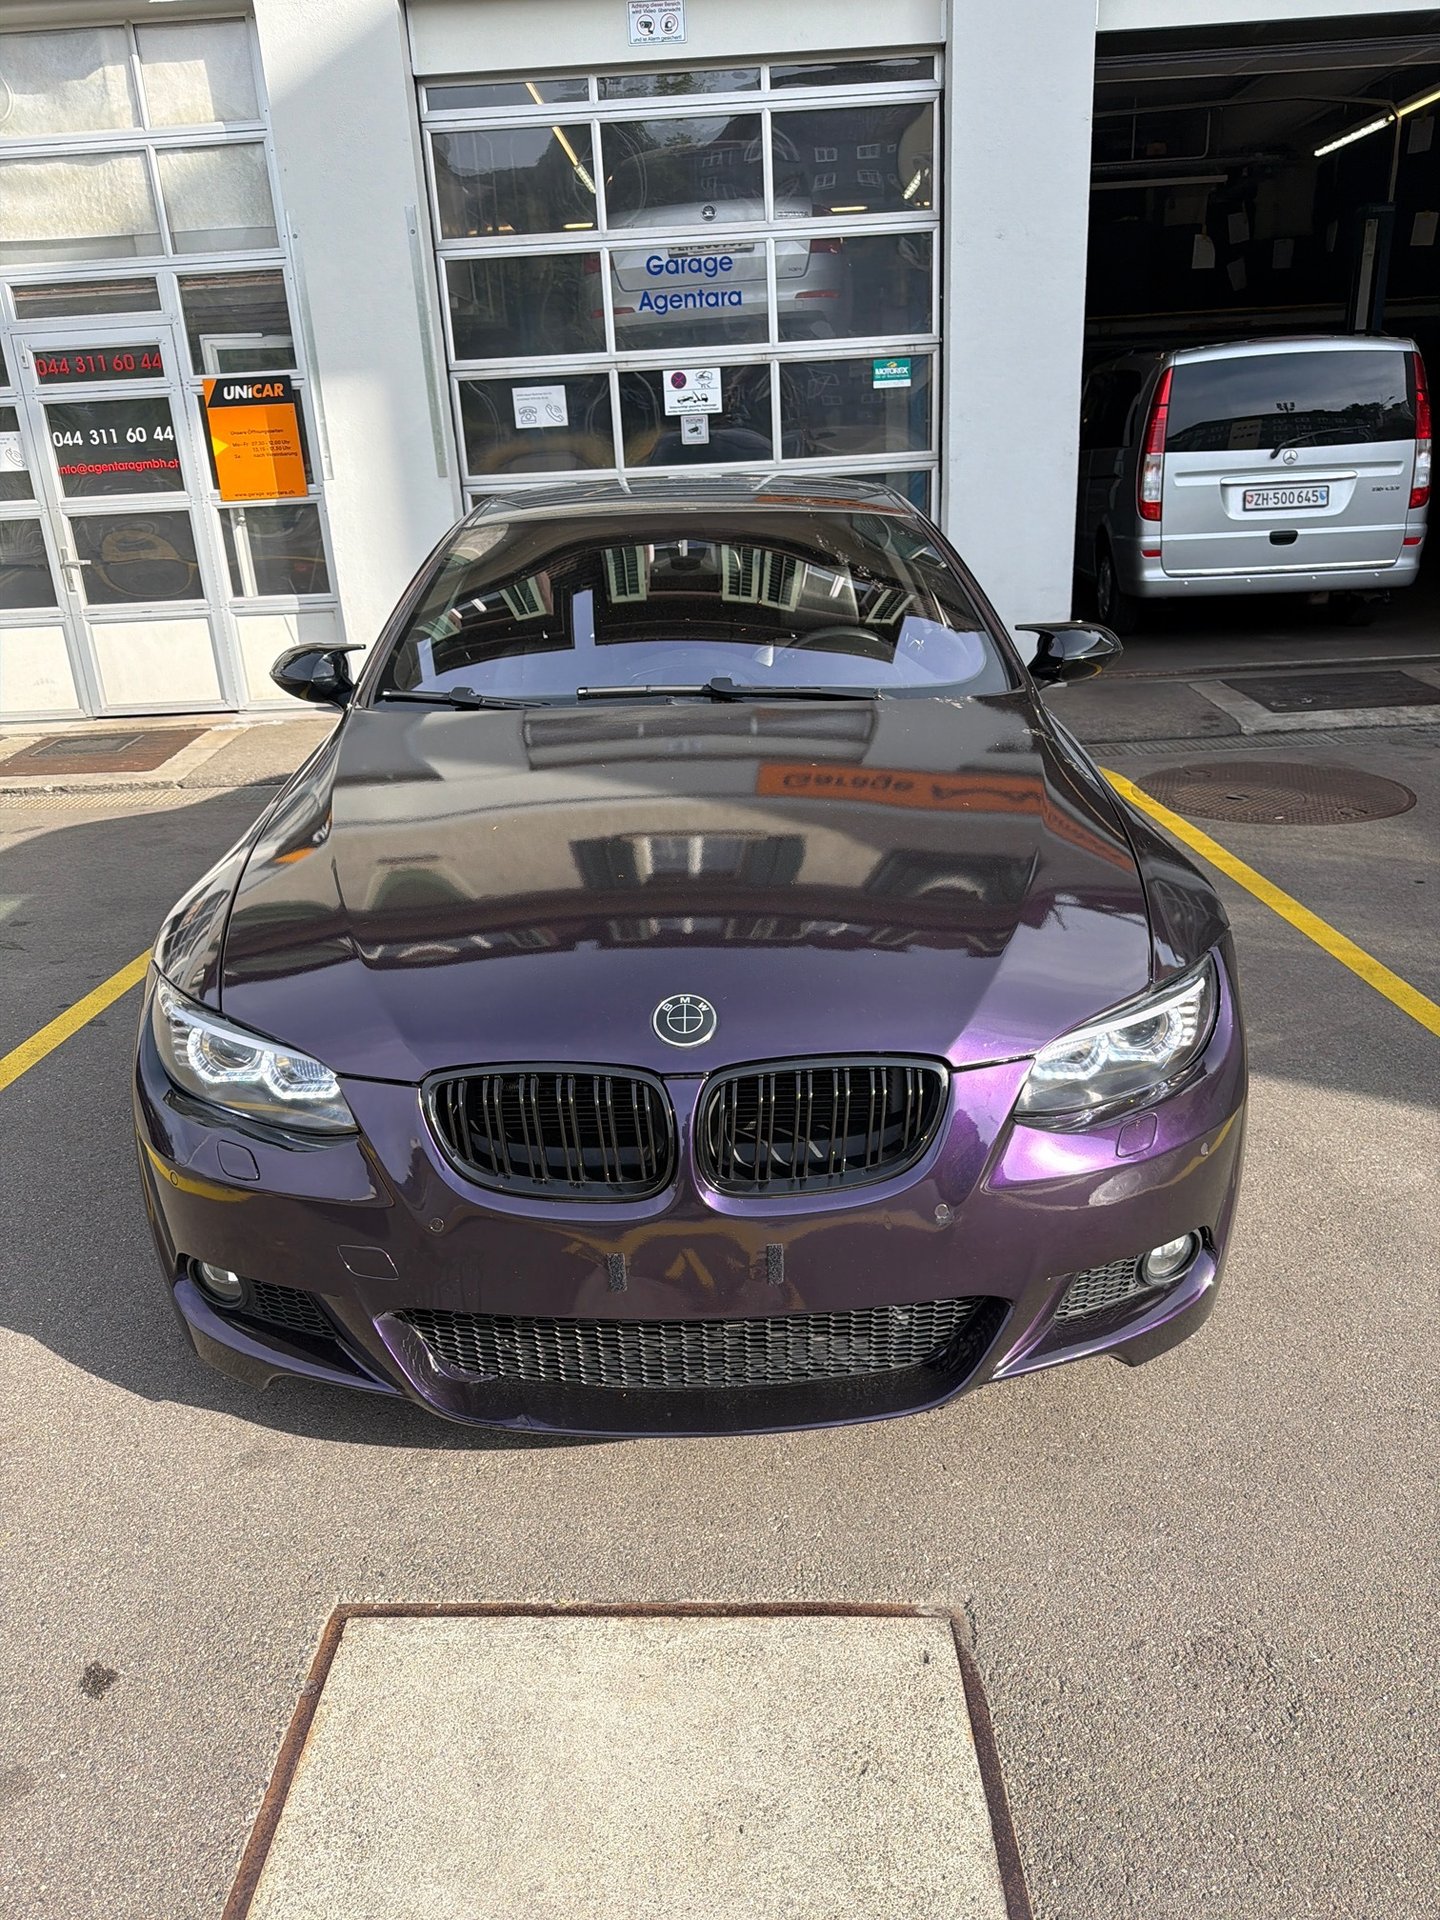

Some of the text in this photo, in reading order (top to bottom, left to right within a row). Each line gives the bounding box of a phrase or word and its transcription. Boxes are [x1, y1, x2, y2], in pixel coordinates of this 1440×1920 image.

[645, 255, 734, 278] Garage
[639, 289, 742, 315] Agentara
[36, 352, 162, 377] 044 311 60 44
[52, 425, 174, 447] 044 311 60 44
[661, 996, 710, 1012] BMW
